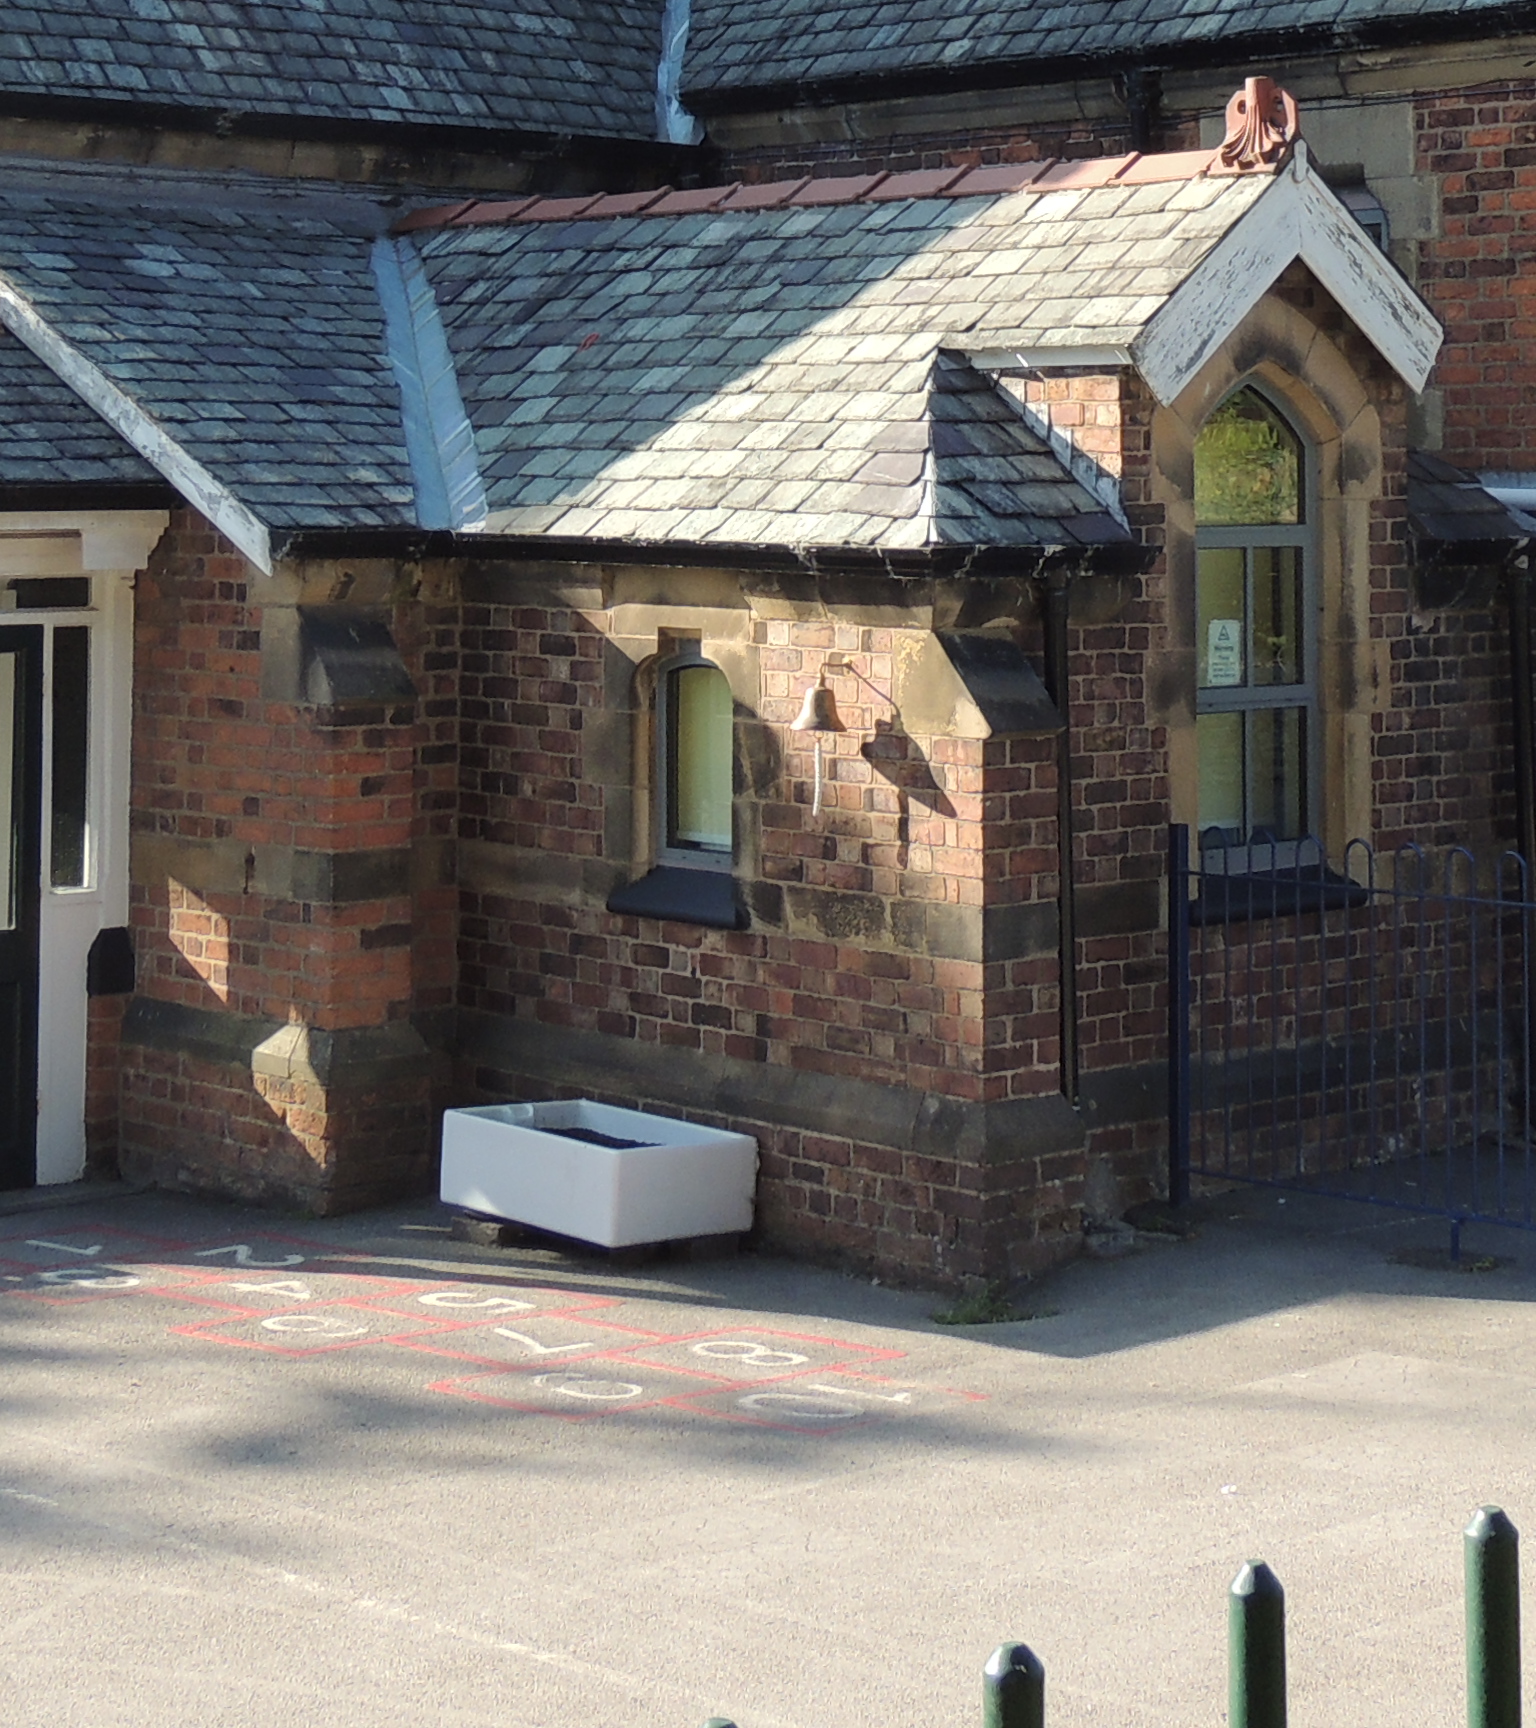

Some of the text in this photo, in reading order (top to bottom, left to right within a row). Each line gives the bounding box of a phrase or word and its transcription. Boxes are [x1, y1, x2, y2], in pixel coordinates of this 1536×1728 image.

[26, 1240, 103, 1256] 1
[194, 1244, 306, 1267] 2
[229, 1280, 311, 1299] 4
[417, 1292, 537, 1313] 5
[494, 1327, 595, 1354] 7
[693, 1341, 809, 1366] 8
